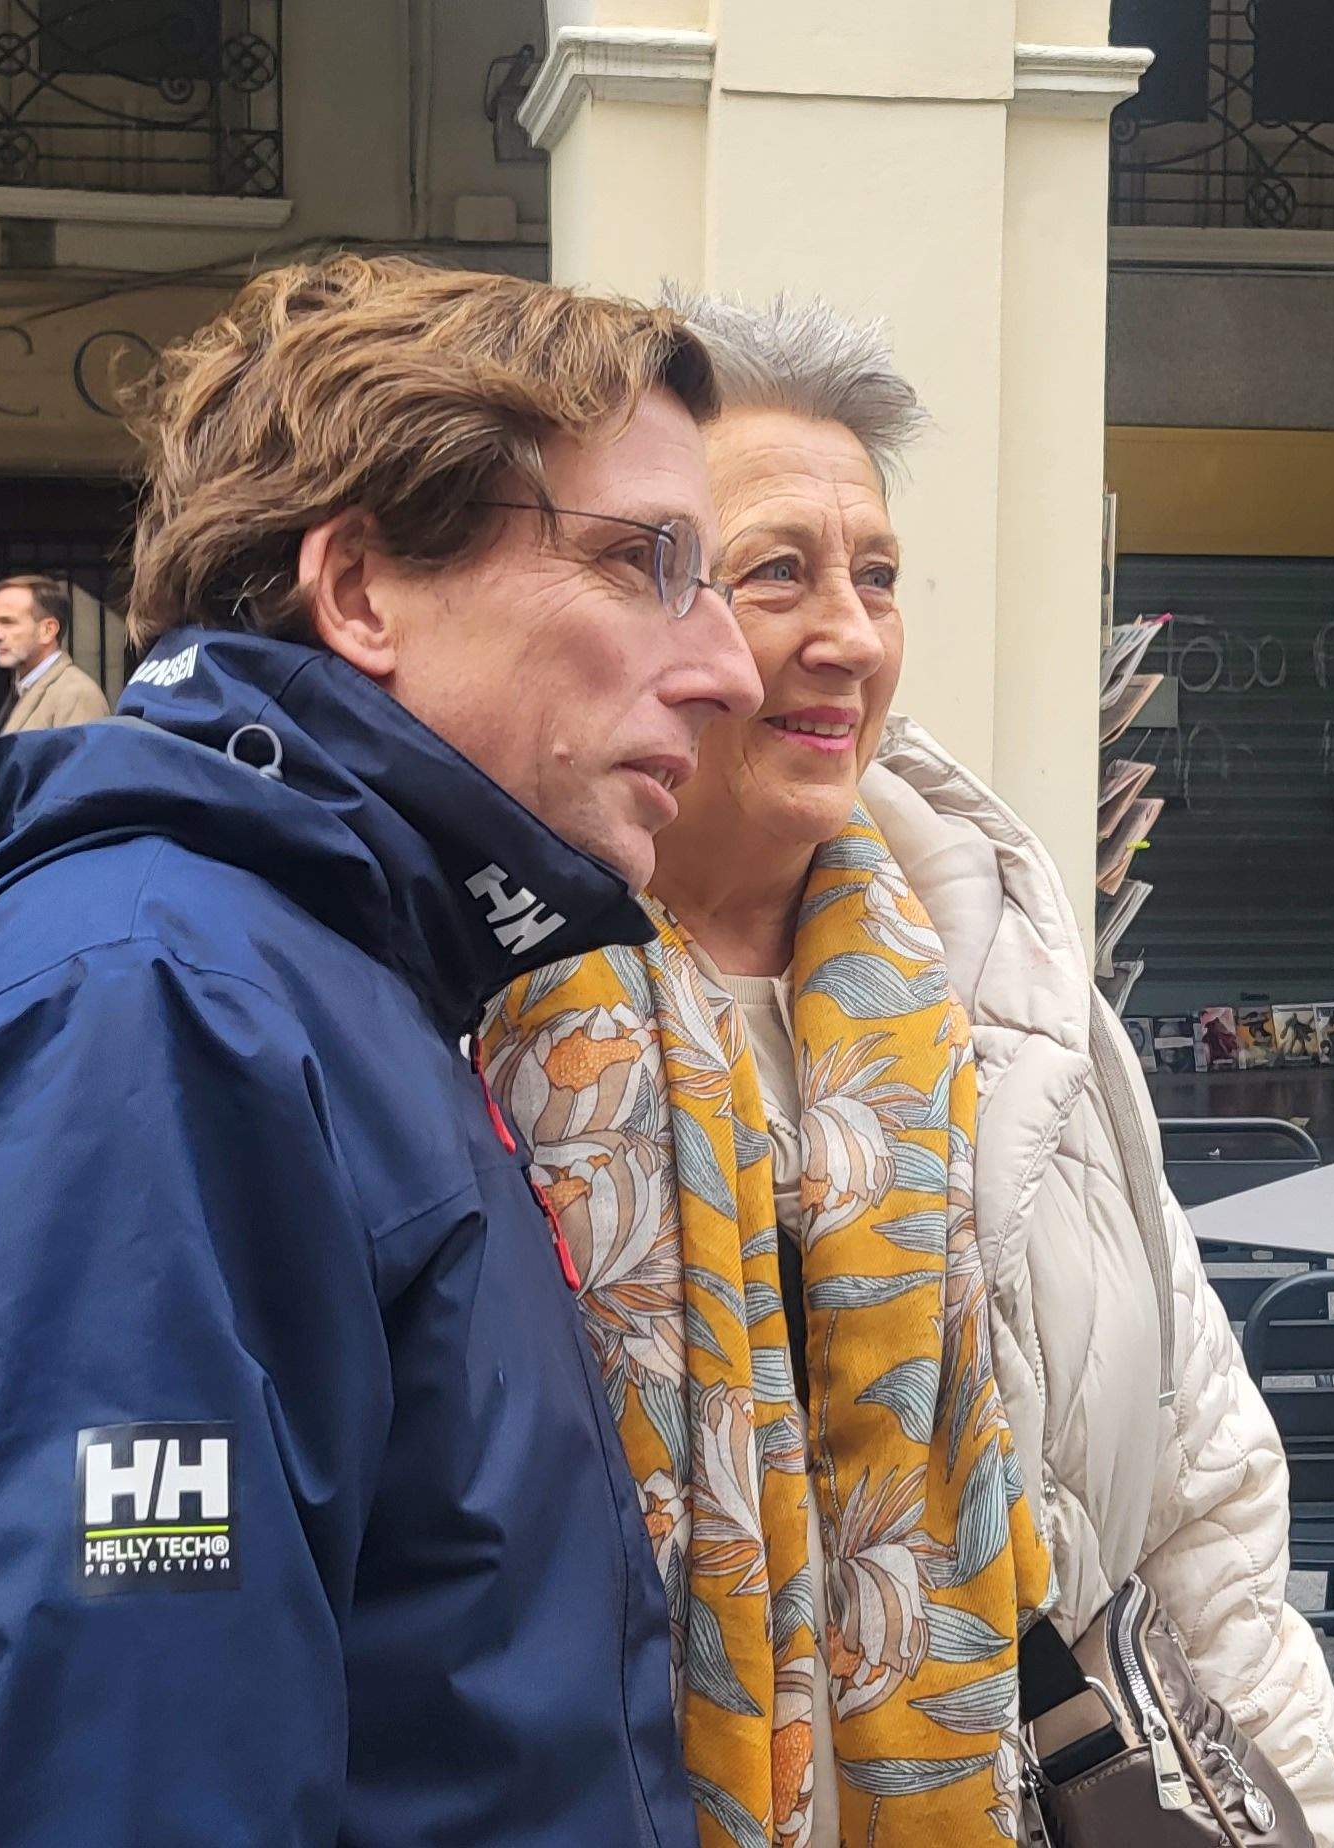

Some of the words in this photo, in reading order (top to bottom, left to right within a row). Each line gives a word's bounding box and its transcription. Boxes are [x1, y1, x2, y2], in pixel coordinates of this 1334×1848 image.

[464, 862, 567, 955] HH
[85, 1438, 229, 1525] HH
[84, 1557, 230, 1578] PROTECTION
[85, 1537, 153, 1563] HELLY
